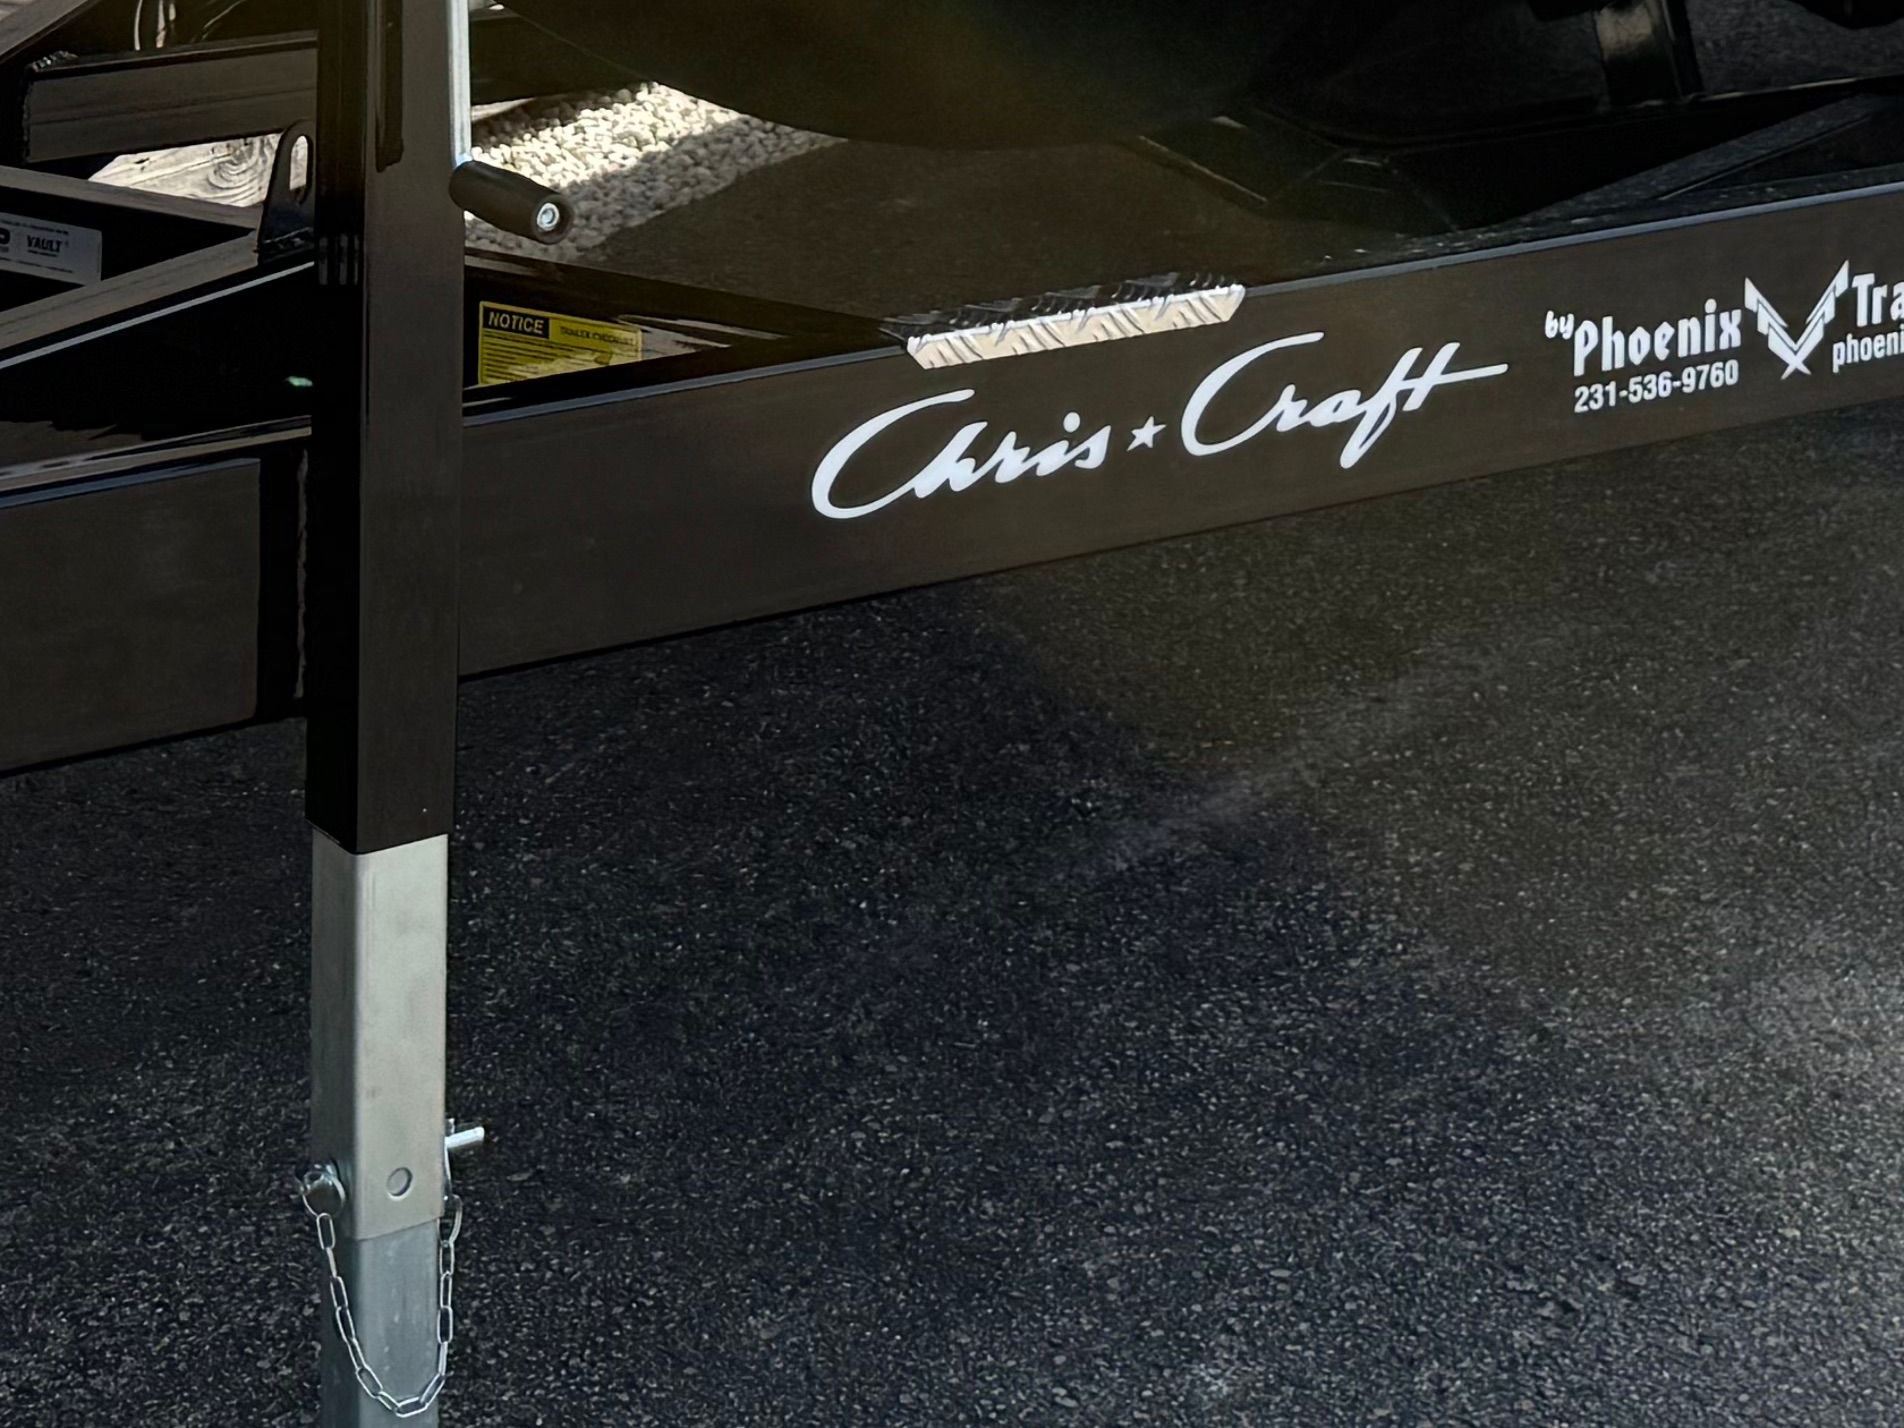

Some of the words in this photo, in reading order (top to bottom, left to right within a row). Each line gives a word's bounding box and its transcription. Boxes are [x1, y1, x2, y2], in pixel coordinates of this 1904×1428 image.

[27, 235, 62, 253] VAULT
[488, 311, 545, 335] NOTICE
[1545, 310, 1574, 340] by
[1573, 298, 1743, 377] Phoenix
[1573, 359, 1740, 414] 231-536-9760
[811, 389, 1112, 519] Chris
[1180, 331, 1509, 469] Craft
